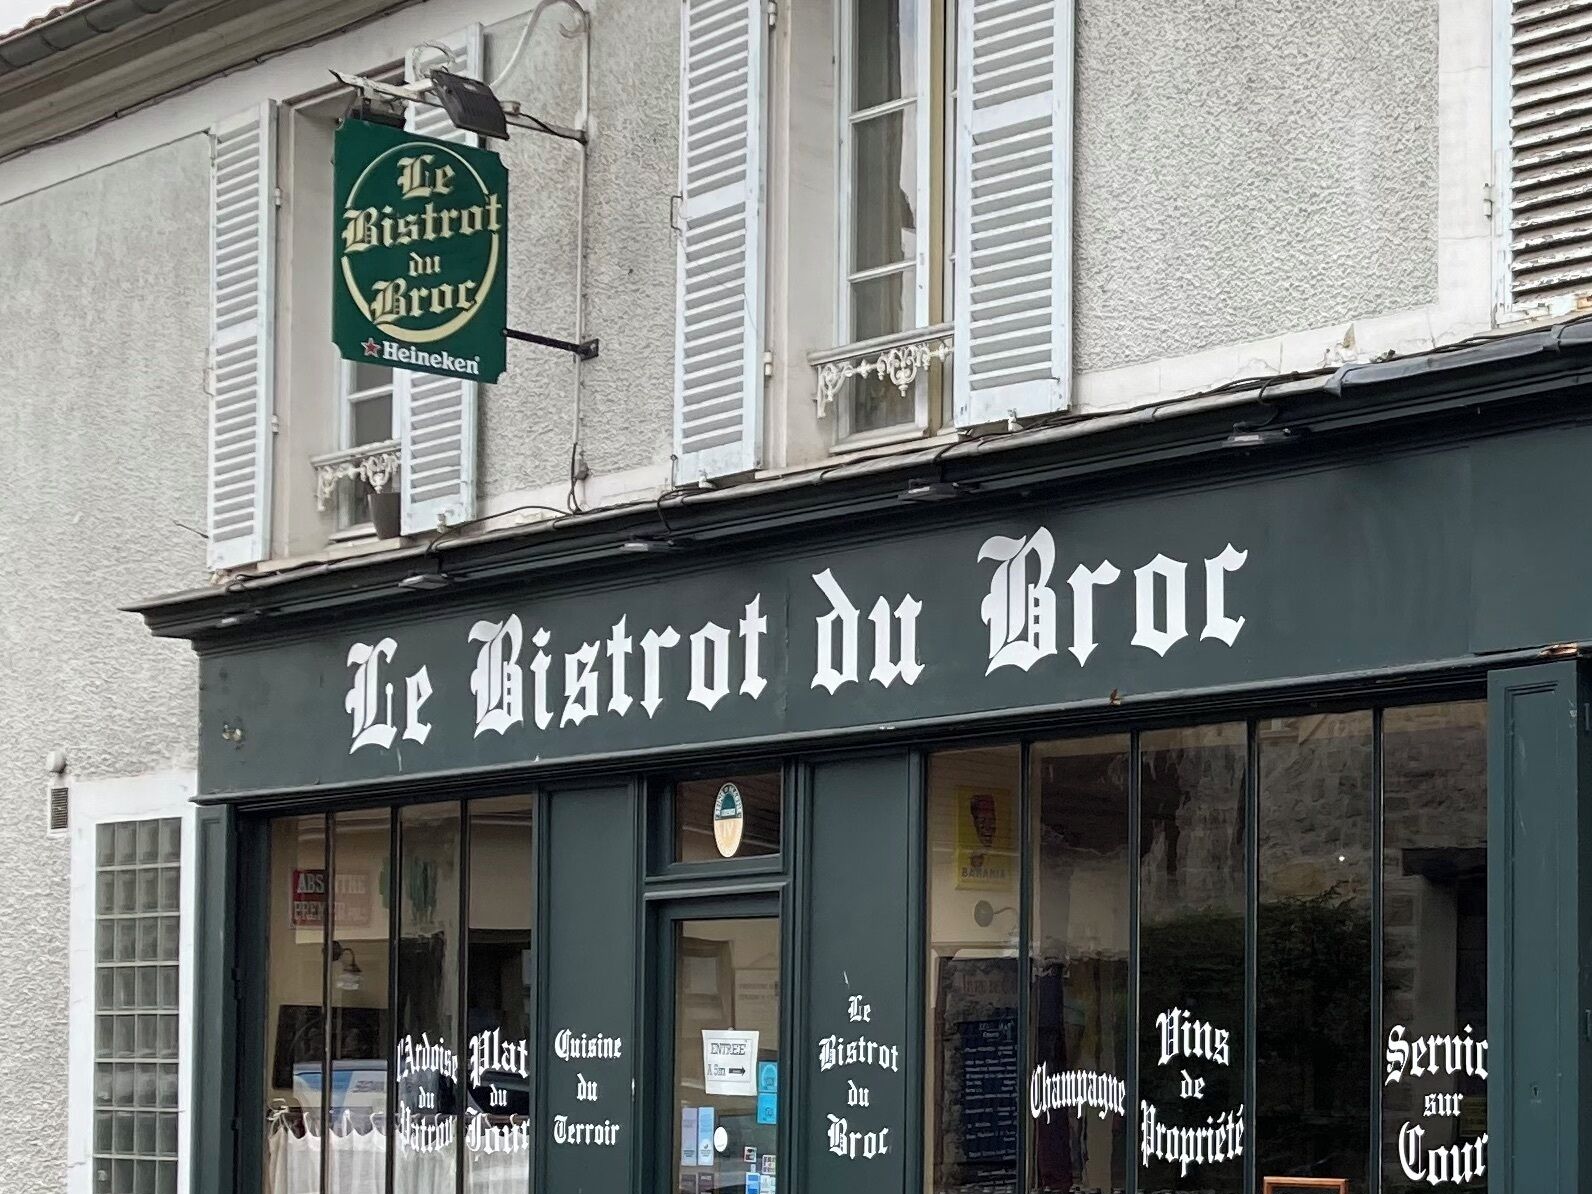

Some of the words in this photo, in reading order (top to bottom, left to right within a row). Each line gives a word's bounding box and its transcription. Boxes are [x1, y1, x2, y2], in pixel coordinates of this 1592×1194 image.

[397, 154, 455, 199] Le
[341, 193, 502, 253] Bistrot
[408, 251, 441, 277] du
[371, 278, 477, 325] Broc
[382, 340, 480, 375] Heineken
[345, 638, 433, 754] Le
[468, 593, 769, 737] Bistrot
[811, 568, 925, 695] du
[977, 527, 1248, 676] Broc
[848, 995, 871, 1022] Le
[555, 1029, 621, 1061] Cuisine
[819, 1035, 899, 1072] Bistrot
[1156, 1007, 1229, 1066] Vins
[469, 1026, 528, 1089] Plat
[418, 1086, 435, 1109] du
[489, 1083, 507, 1107] du
[577, 1073, 598, 1101] du
[848, 1080, 869, 1107] du
[1031, 1062, 1126, 1120] Champagne
[1180, 1070, 1205, 1099] de
[1423, 1093, 1463, 1117] sur
[465, 1106, 530, 1155] Jour
[554, 1115, 619, 1146] Terroir
[827, 1114, 888, 1159] Broc
[1399, 1121, 1488, 1185] Cour
